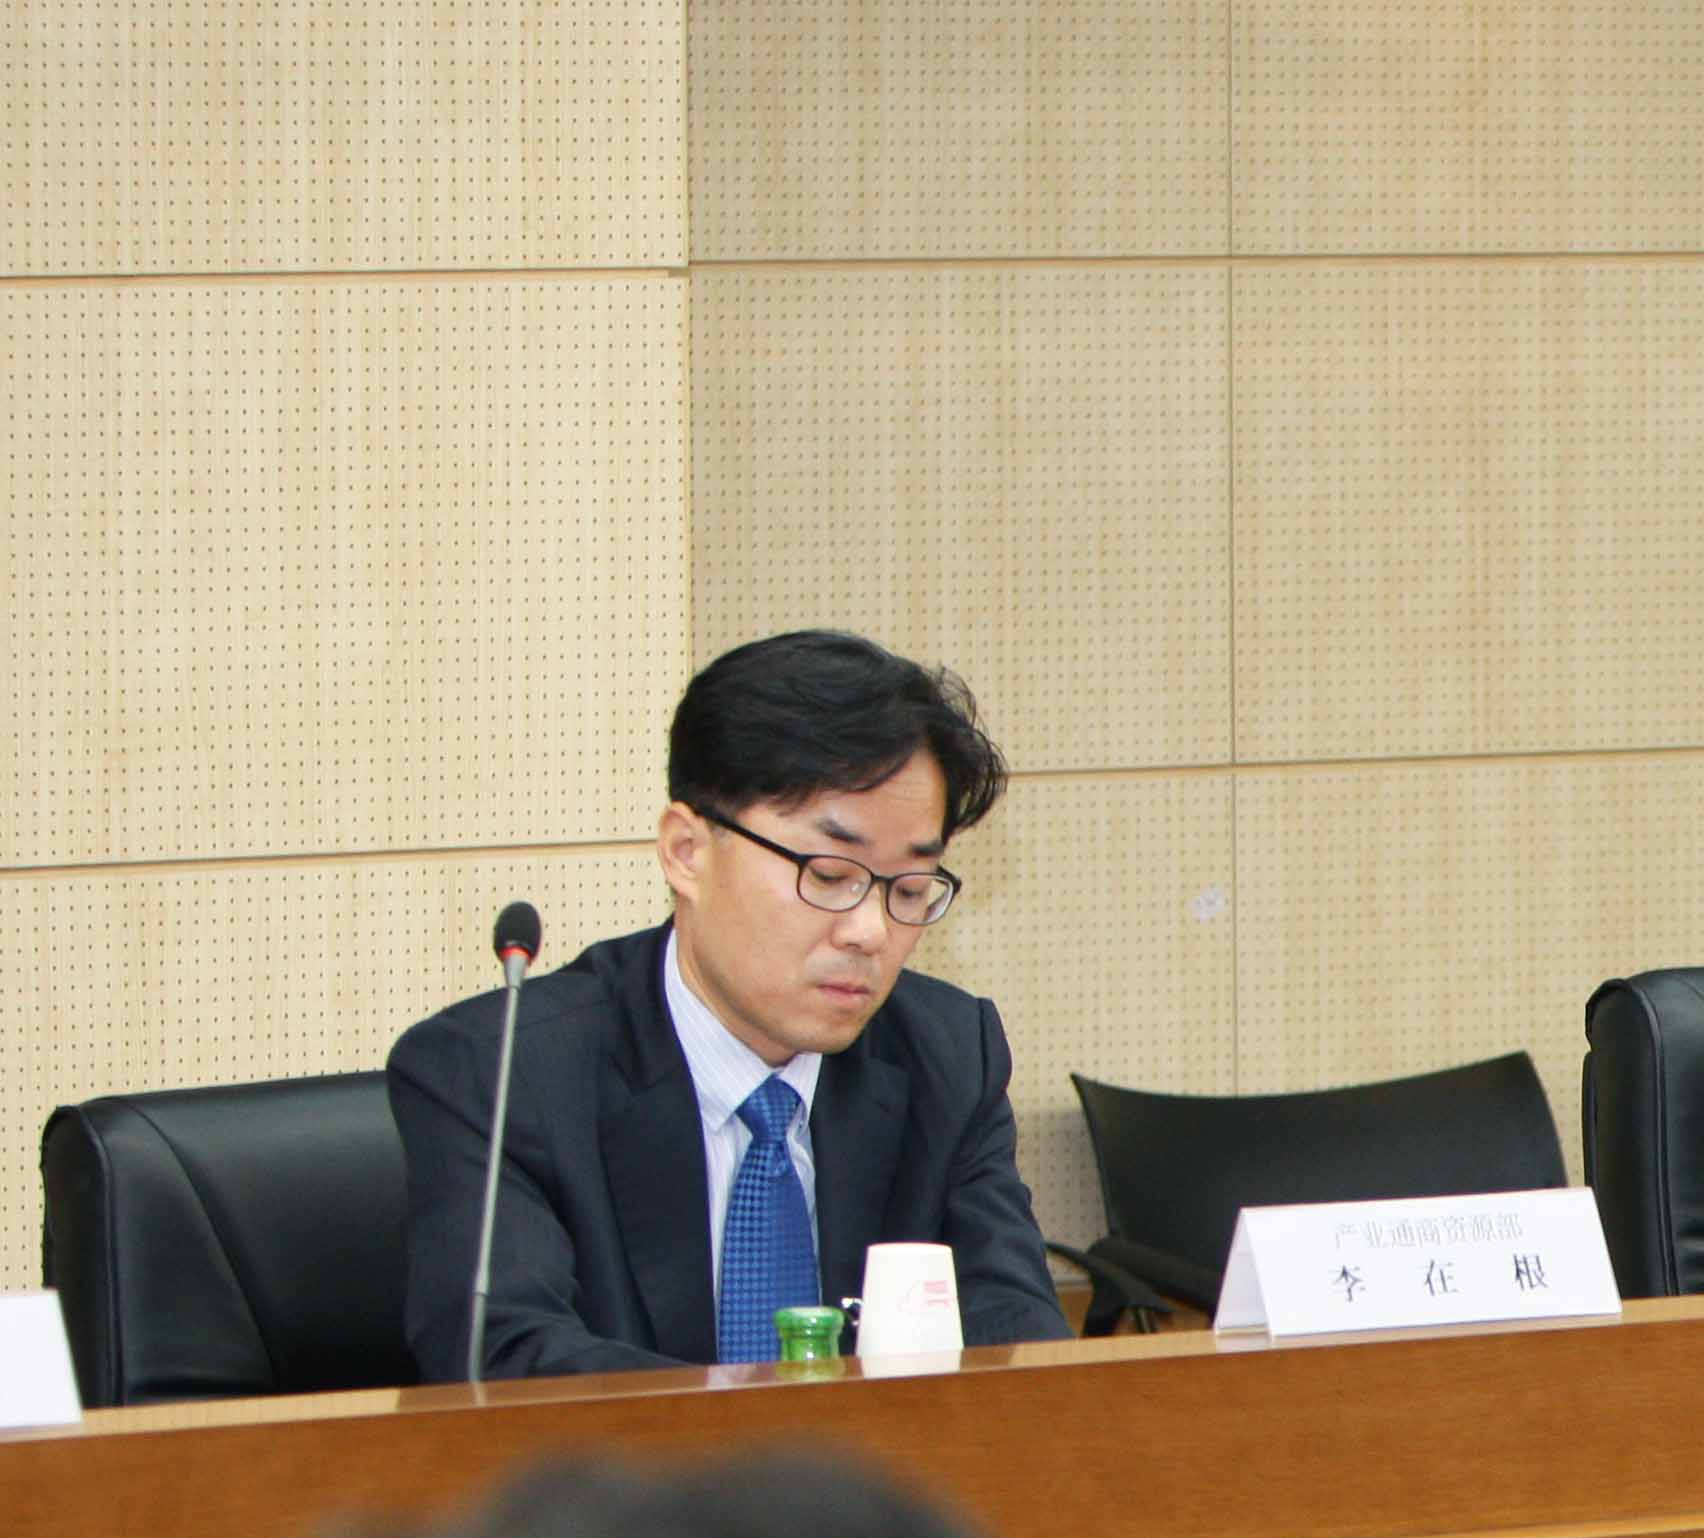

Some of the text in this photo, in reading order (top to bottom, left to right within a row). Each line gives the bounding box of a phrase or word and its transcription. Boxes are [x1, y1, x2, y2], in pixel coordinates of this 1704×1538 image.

[1333, 1213, 1524, 1249] 产业通商资源部
